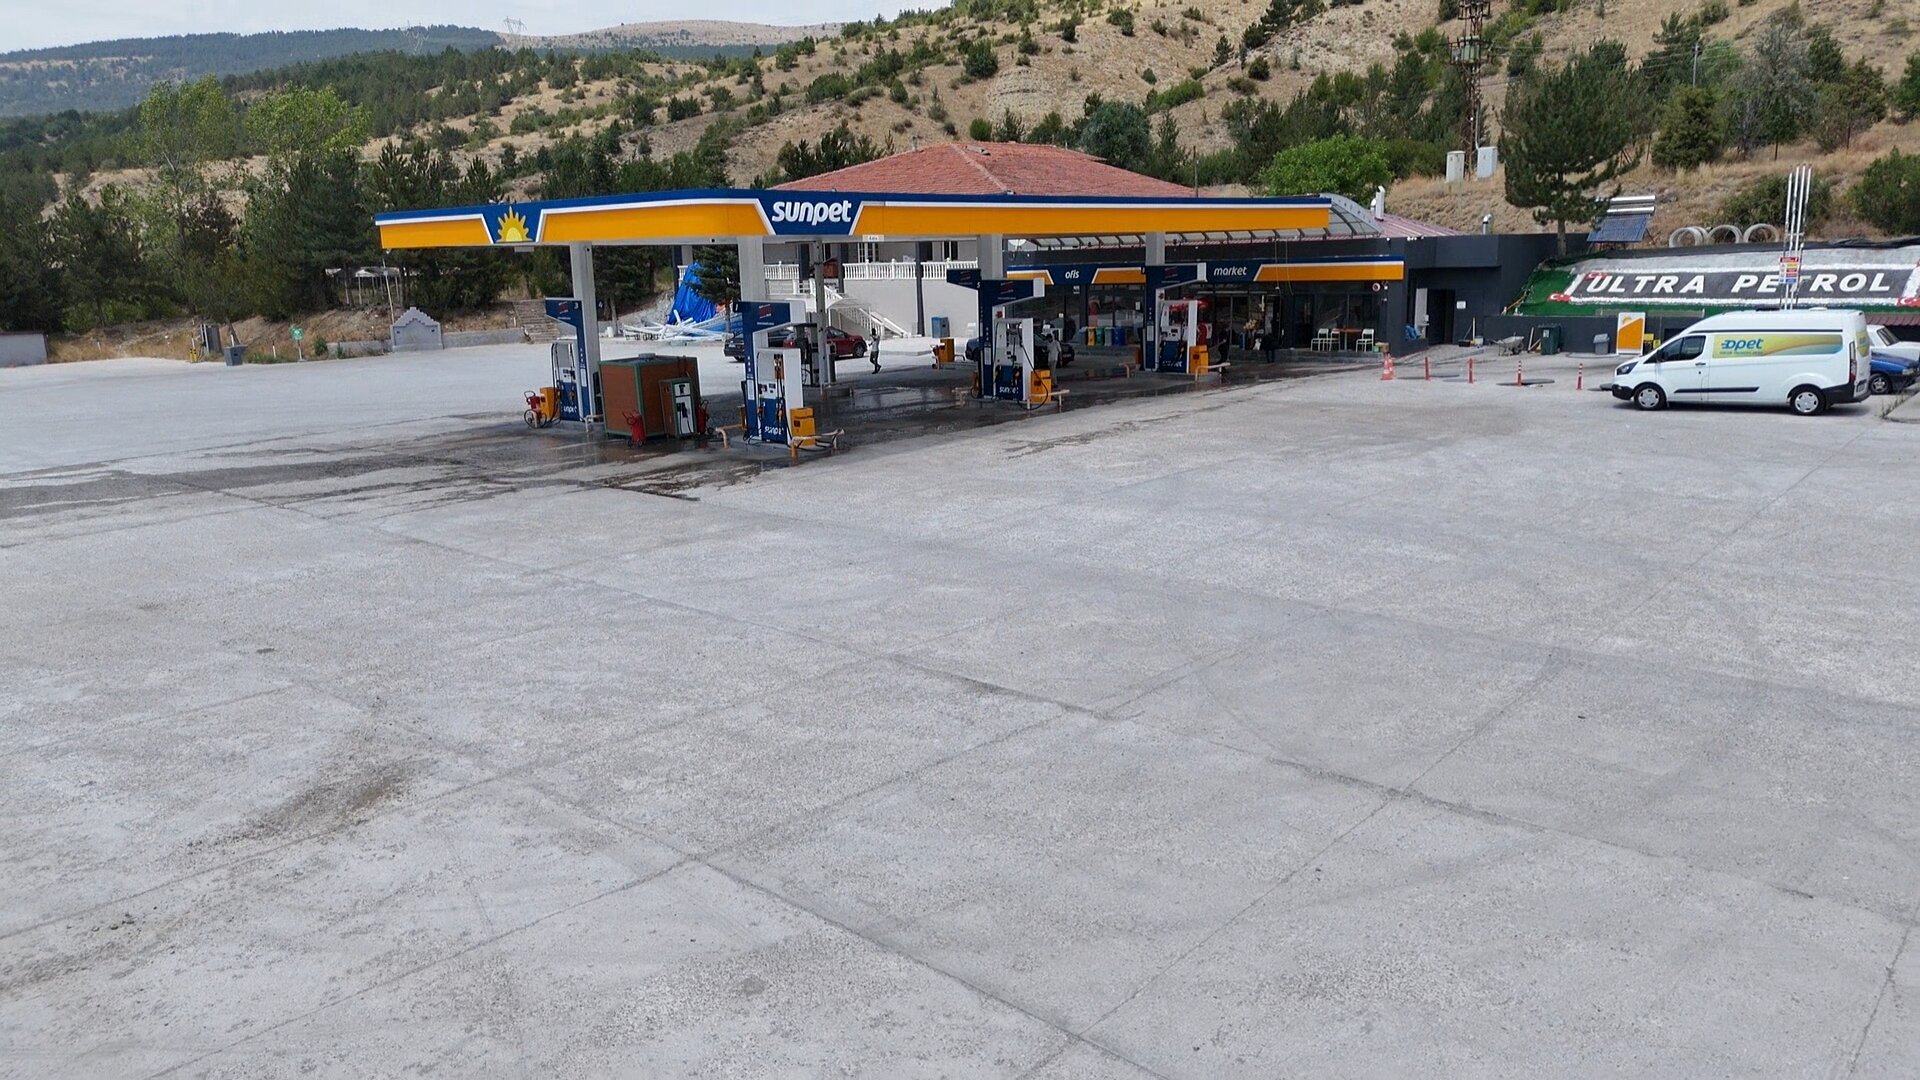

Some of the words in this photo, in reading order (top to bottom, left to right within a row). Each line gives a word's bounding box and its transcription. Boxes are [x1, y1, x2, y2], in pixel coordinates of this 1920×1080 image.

[772, 200, 852, 226] sunpet
[1065, 269, 1080, 279] ofis
[1213, 265, 1247, 276] market
[1586, 275, 1705, 293] ULTRA
[1721, 338, 1764, 351] opet
